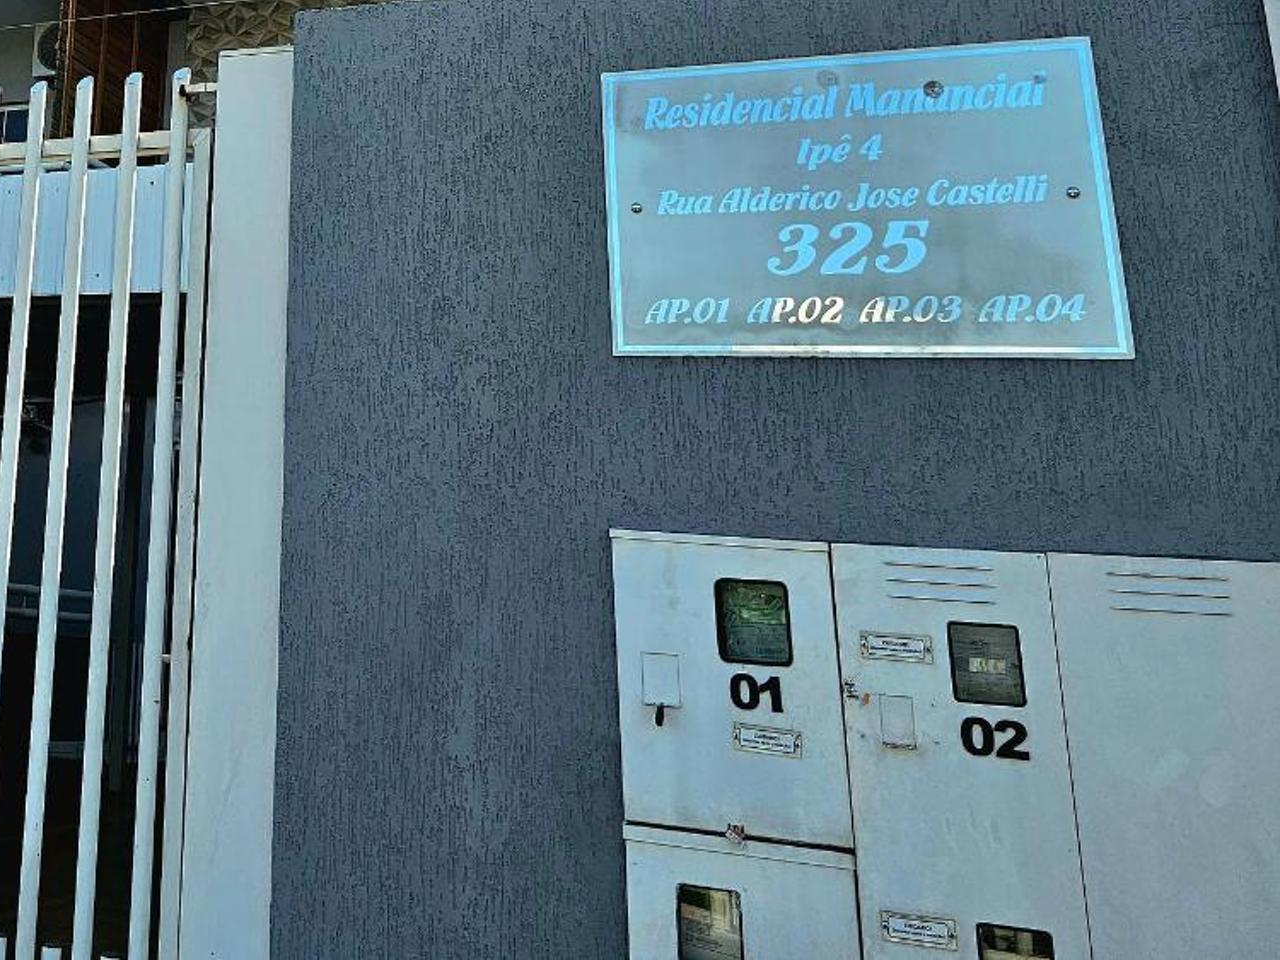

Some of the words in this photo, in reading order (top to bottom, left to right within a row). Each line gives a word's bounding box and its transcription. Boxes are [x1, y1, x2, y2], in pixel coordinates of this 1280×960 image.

[644, 84, 838, 130] Residencial
[845, 71, 1047, 117] Manancial
[796, 134, 851, 170] Ipê
[858, 133, 884, 161] 4
[656, 189, 712, 215] Rua
[719, 182, 841, 214] Alderico
[848, 183, 919, 212] Jose
[926, 174, 1049, 206] Castelli
[767, 219, 930, 277] 325
[644, 297, 729, 325] AP.01
[747, 296, 844, 325] AP.02
[858, 294, 963, 325] AP.03
[978, 292, 1088, 323] AP.04
[730, 672, 783, 713] 01
[961, 716, 1030, 761] 02
